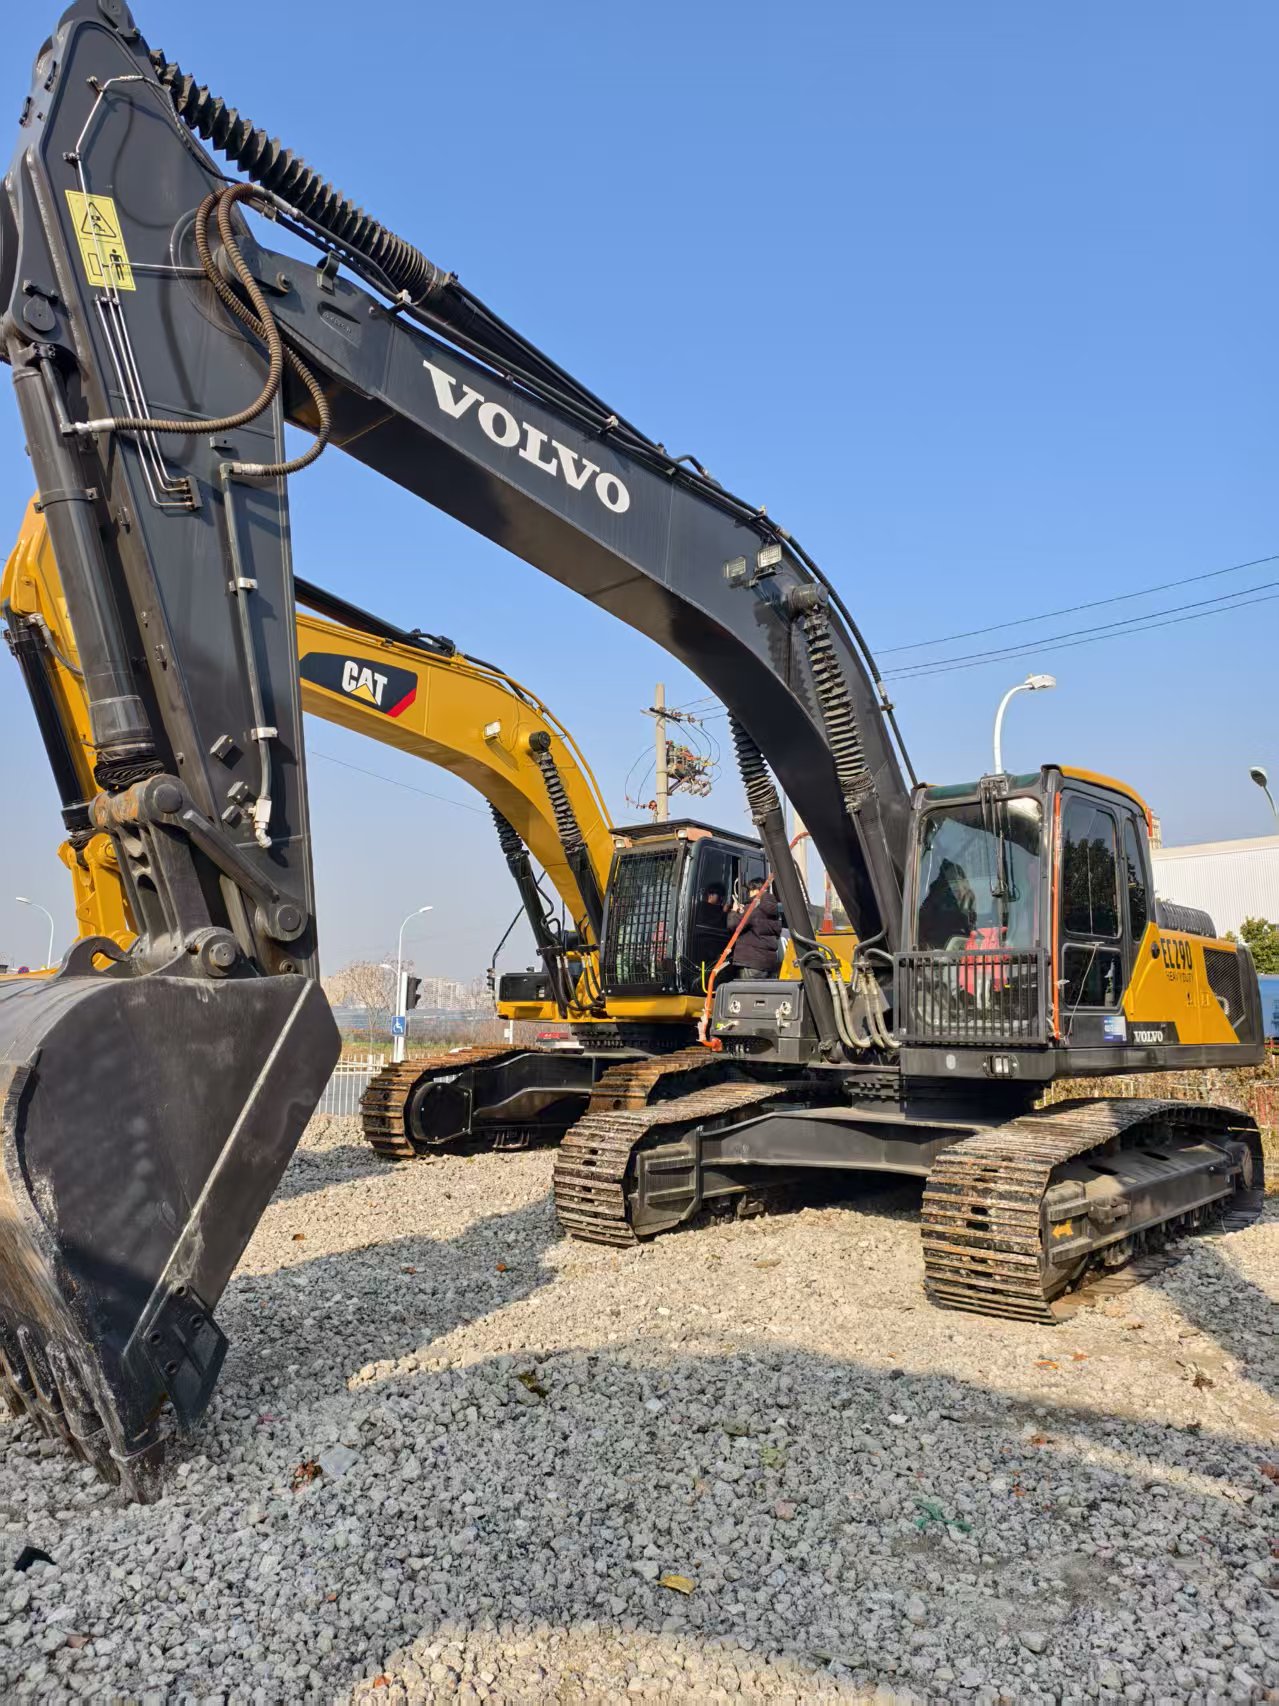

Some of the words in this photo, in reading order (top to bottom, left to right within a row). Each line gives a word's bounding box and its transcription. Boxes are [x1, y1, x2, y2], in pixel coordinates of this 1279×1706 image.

[423, 360, 630, 513] VOLVO
[342, 660, 388, 706] CAT
[1160, 937, 1193, 970] EC290
[1133, 1031, 1163, 1042] VOLVO
